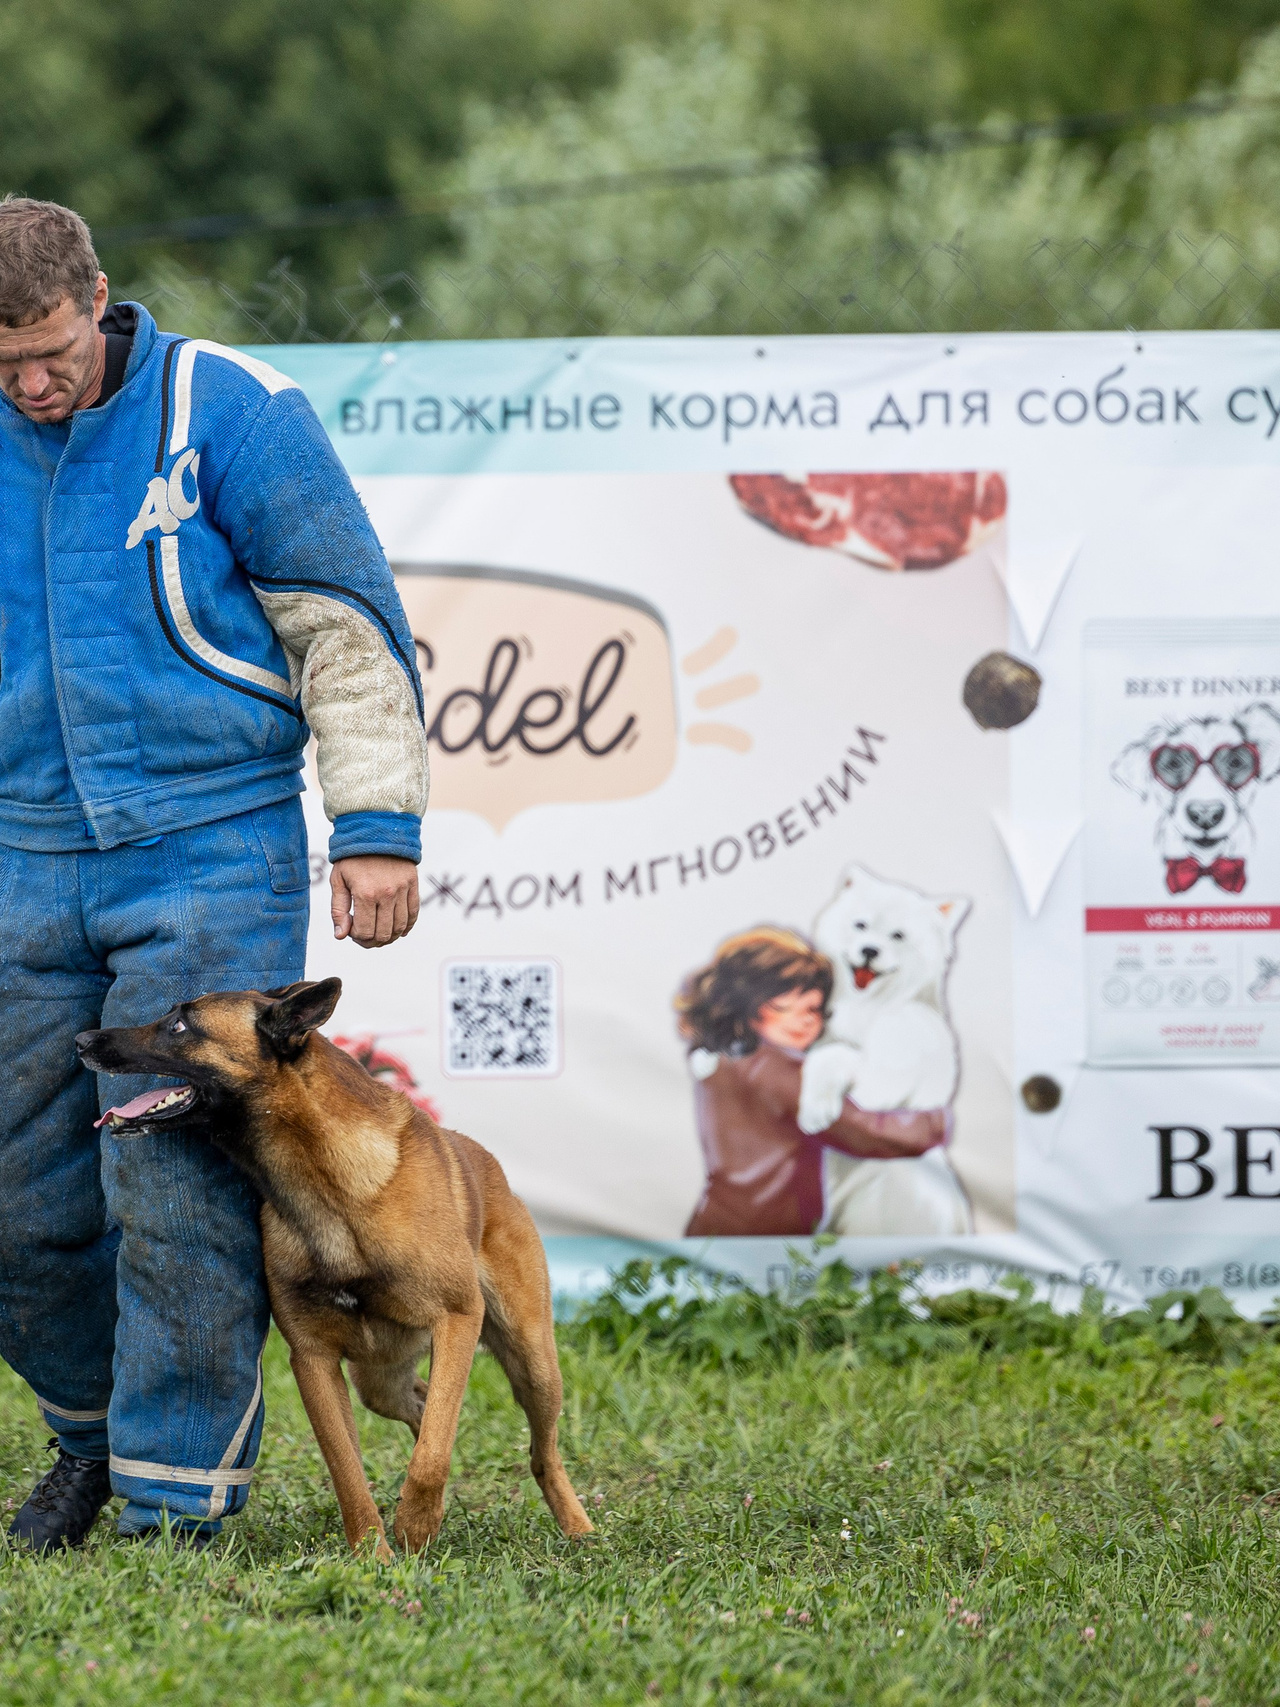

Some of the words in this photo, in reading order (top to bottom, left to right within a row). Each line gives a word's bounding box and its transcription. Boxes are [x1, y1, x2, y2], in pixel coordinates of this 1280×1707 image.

[339, 393, 622, 434] влажные
[650, 391, 839, 446] корма
[867, 391, 990, 433] для
[1017, 363, 1201, 426] собак
[1125, 677, 1184, 697] BEST
[419, 871, 583, 919] ЖДОМ
[604, 725, 888, 899] МГНОВЕНИИ
[1147, 1125, 1280, 1200] BE
